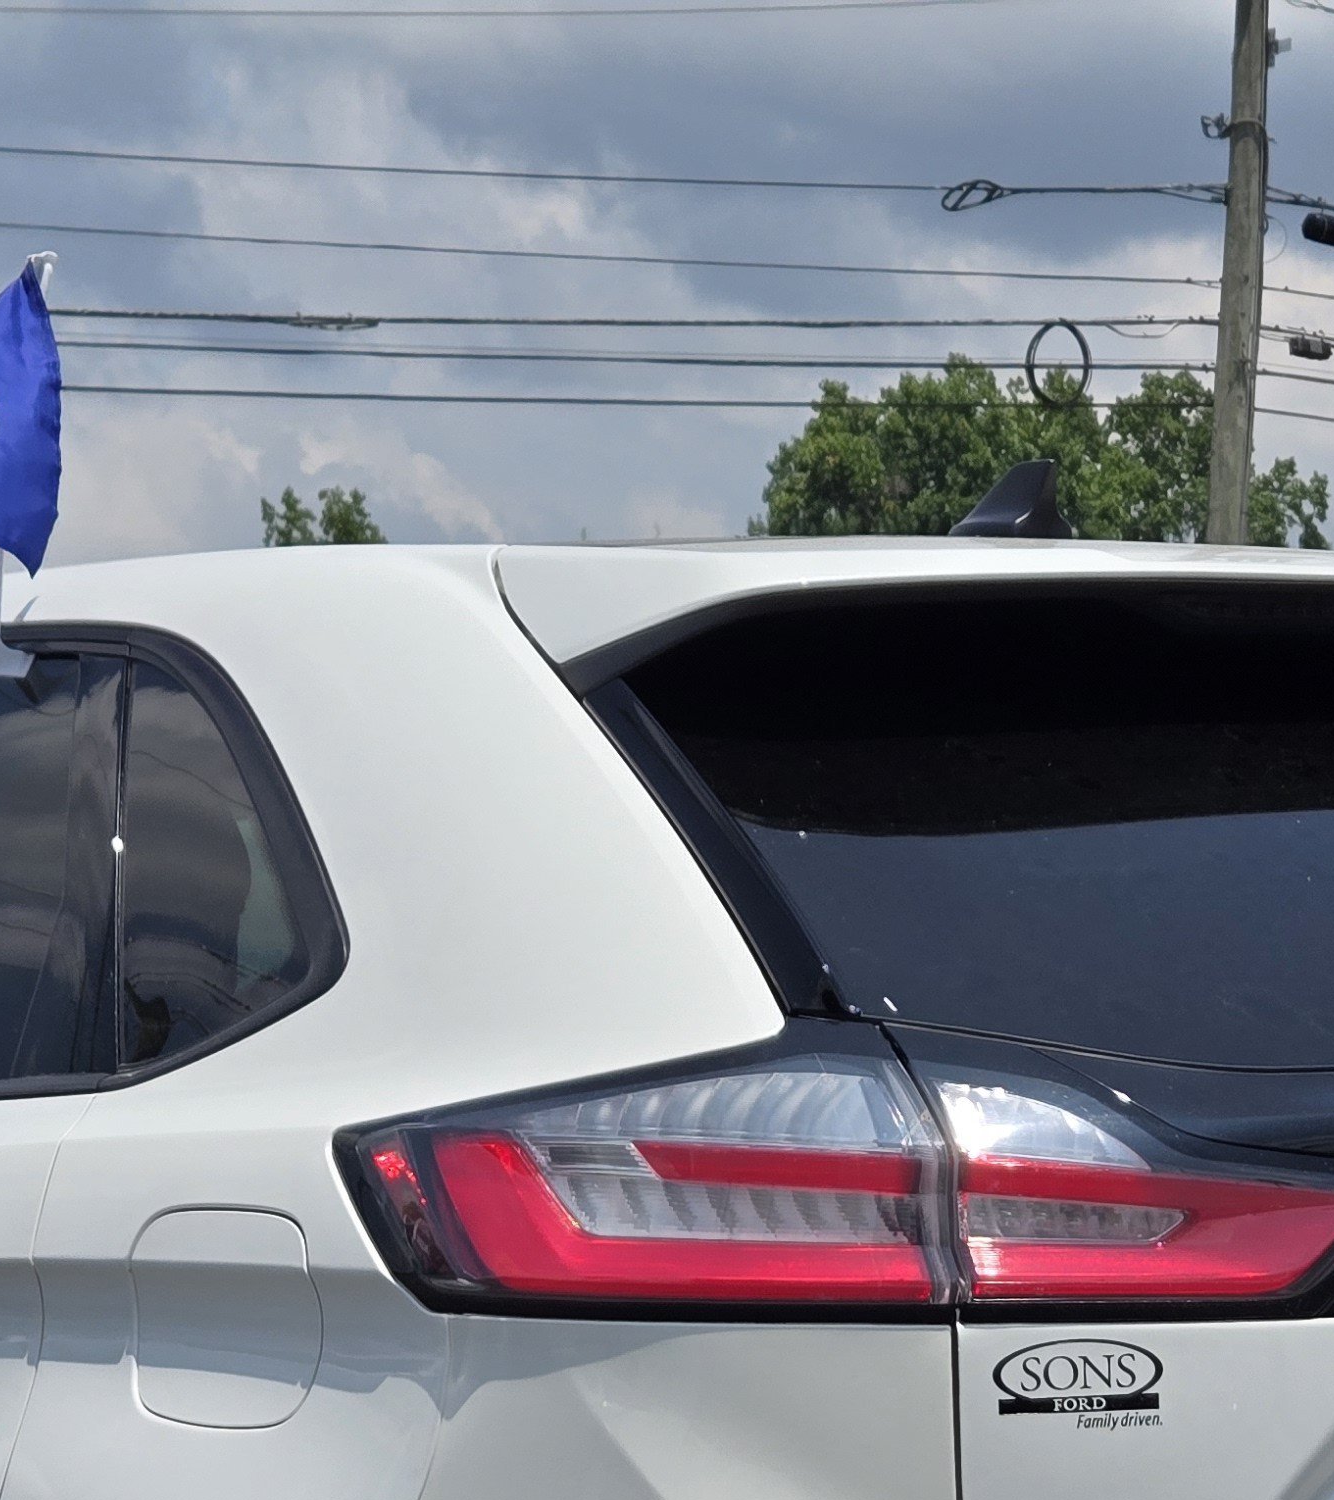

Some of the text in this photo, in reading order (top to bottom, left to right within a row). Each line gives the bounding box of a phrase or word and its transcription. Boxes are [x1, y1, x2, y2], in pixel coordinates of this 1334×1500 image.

[1020, 1353, 1137, 1392] SONS
[1053, 1397, 1107, 1412] FORD
[1077, 1412, 1164, 1431] Family driven.
